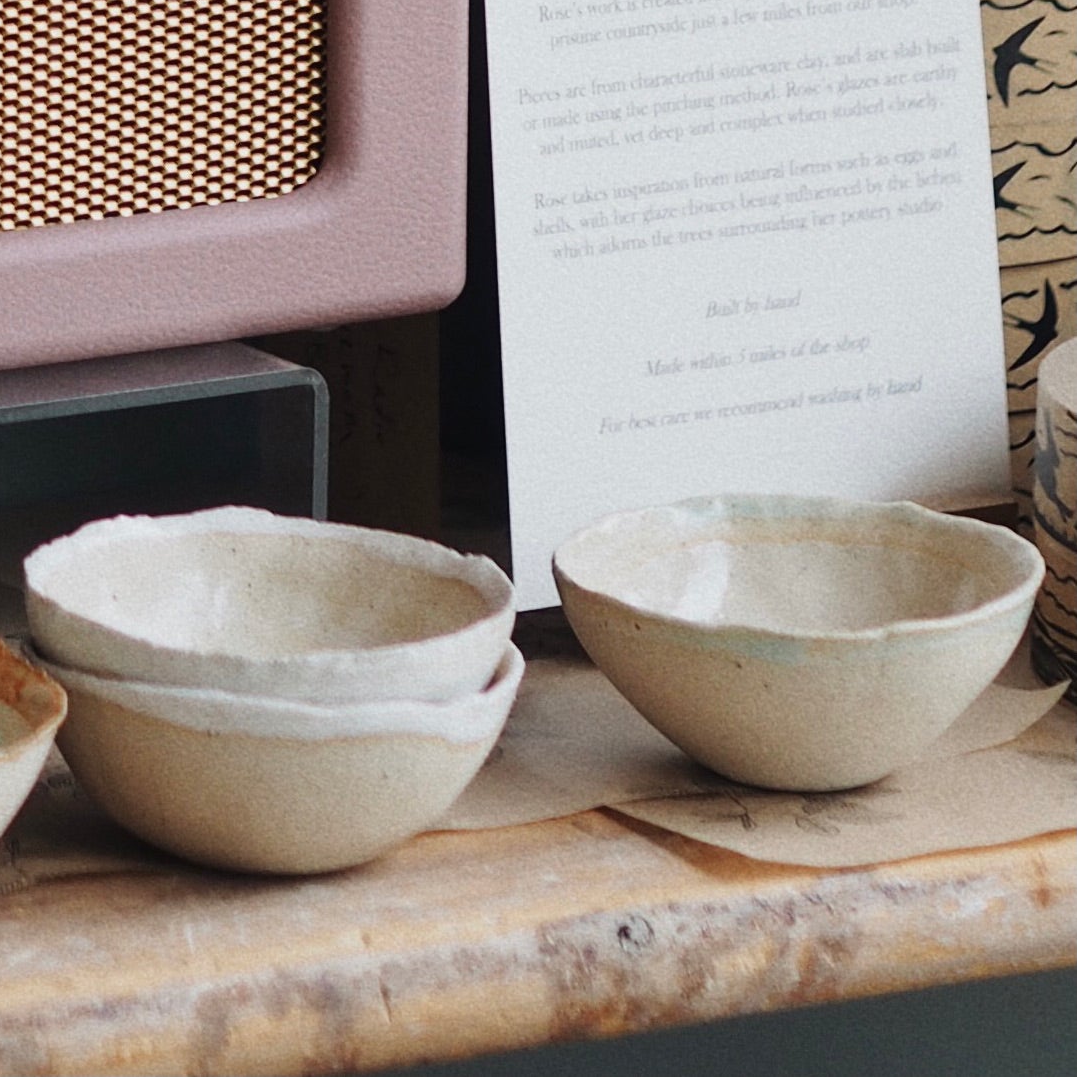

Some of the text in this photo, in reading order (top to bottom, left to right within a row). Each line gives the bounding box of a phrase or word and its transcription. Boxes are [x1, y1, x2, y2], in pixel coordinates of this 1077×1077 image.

[538, 1, 582, 22] Rose's
[606, 15, 686, 40] countryside
[691, 12, 715, 33] just
[721, 15, 729, 27] a
[733, 6, 758, 26] few
[762, 1, 802, 21] miles
[564, 84, 586, 99] are
[592, 76, 624, 95] from
[630, 64, 714, 89] characterful
[719, 59, 790, 79] stoneware
[834, 46, 860, 65] and
[522, 118, 537, 131] or
[542, 108, 580, 128] made
[626, 99, 648, 117] the
[539, 135, 564, 155] and
[648, 121, 683, 145] deep
[688, 118, 714, 136] and
[787, 104, 826, 124] when
[533, 189, 566, 209] Rose
[572, 184, 608, 204] takes
[613, 177, 688, 202] inspiration
[693, 168, 729, 189] from
[734, 161, 784, 183] natural
[790, 155, 832, 176] forms
[930, 141, 957, 160] and
[642, 205, 678, 225] glaze
[784, 179, 862, 203] influenced
[887, 172, 912, 192] the
[552, 239, 594, 260] which
[652, 228, 674, 247] the
[678, 226, 712, 244] trees
[718, 214, 808, 239] surrounding
[763, 289, 802, 311] hand
[644, 356, 684, 377] Made
[809, 337, 830, 355] the
[834, 332, 870, 355] shop
[598, 414, 627, 434] For
[716, 393, 802, 417] recommend
[886, 375, 923, 396] hand
